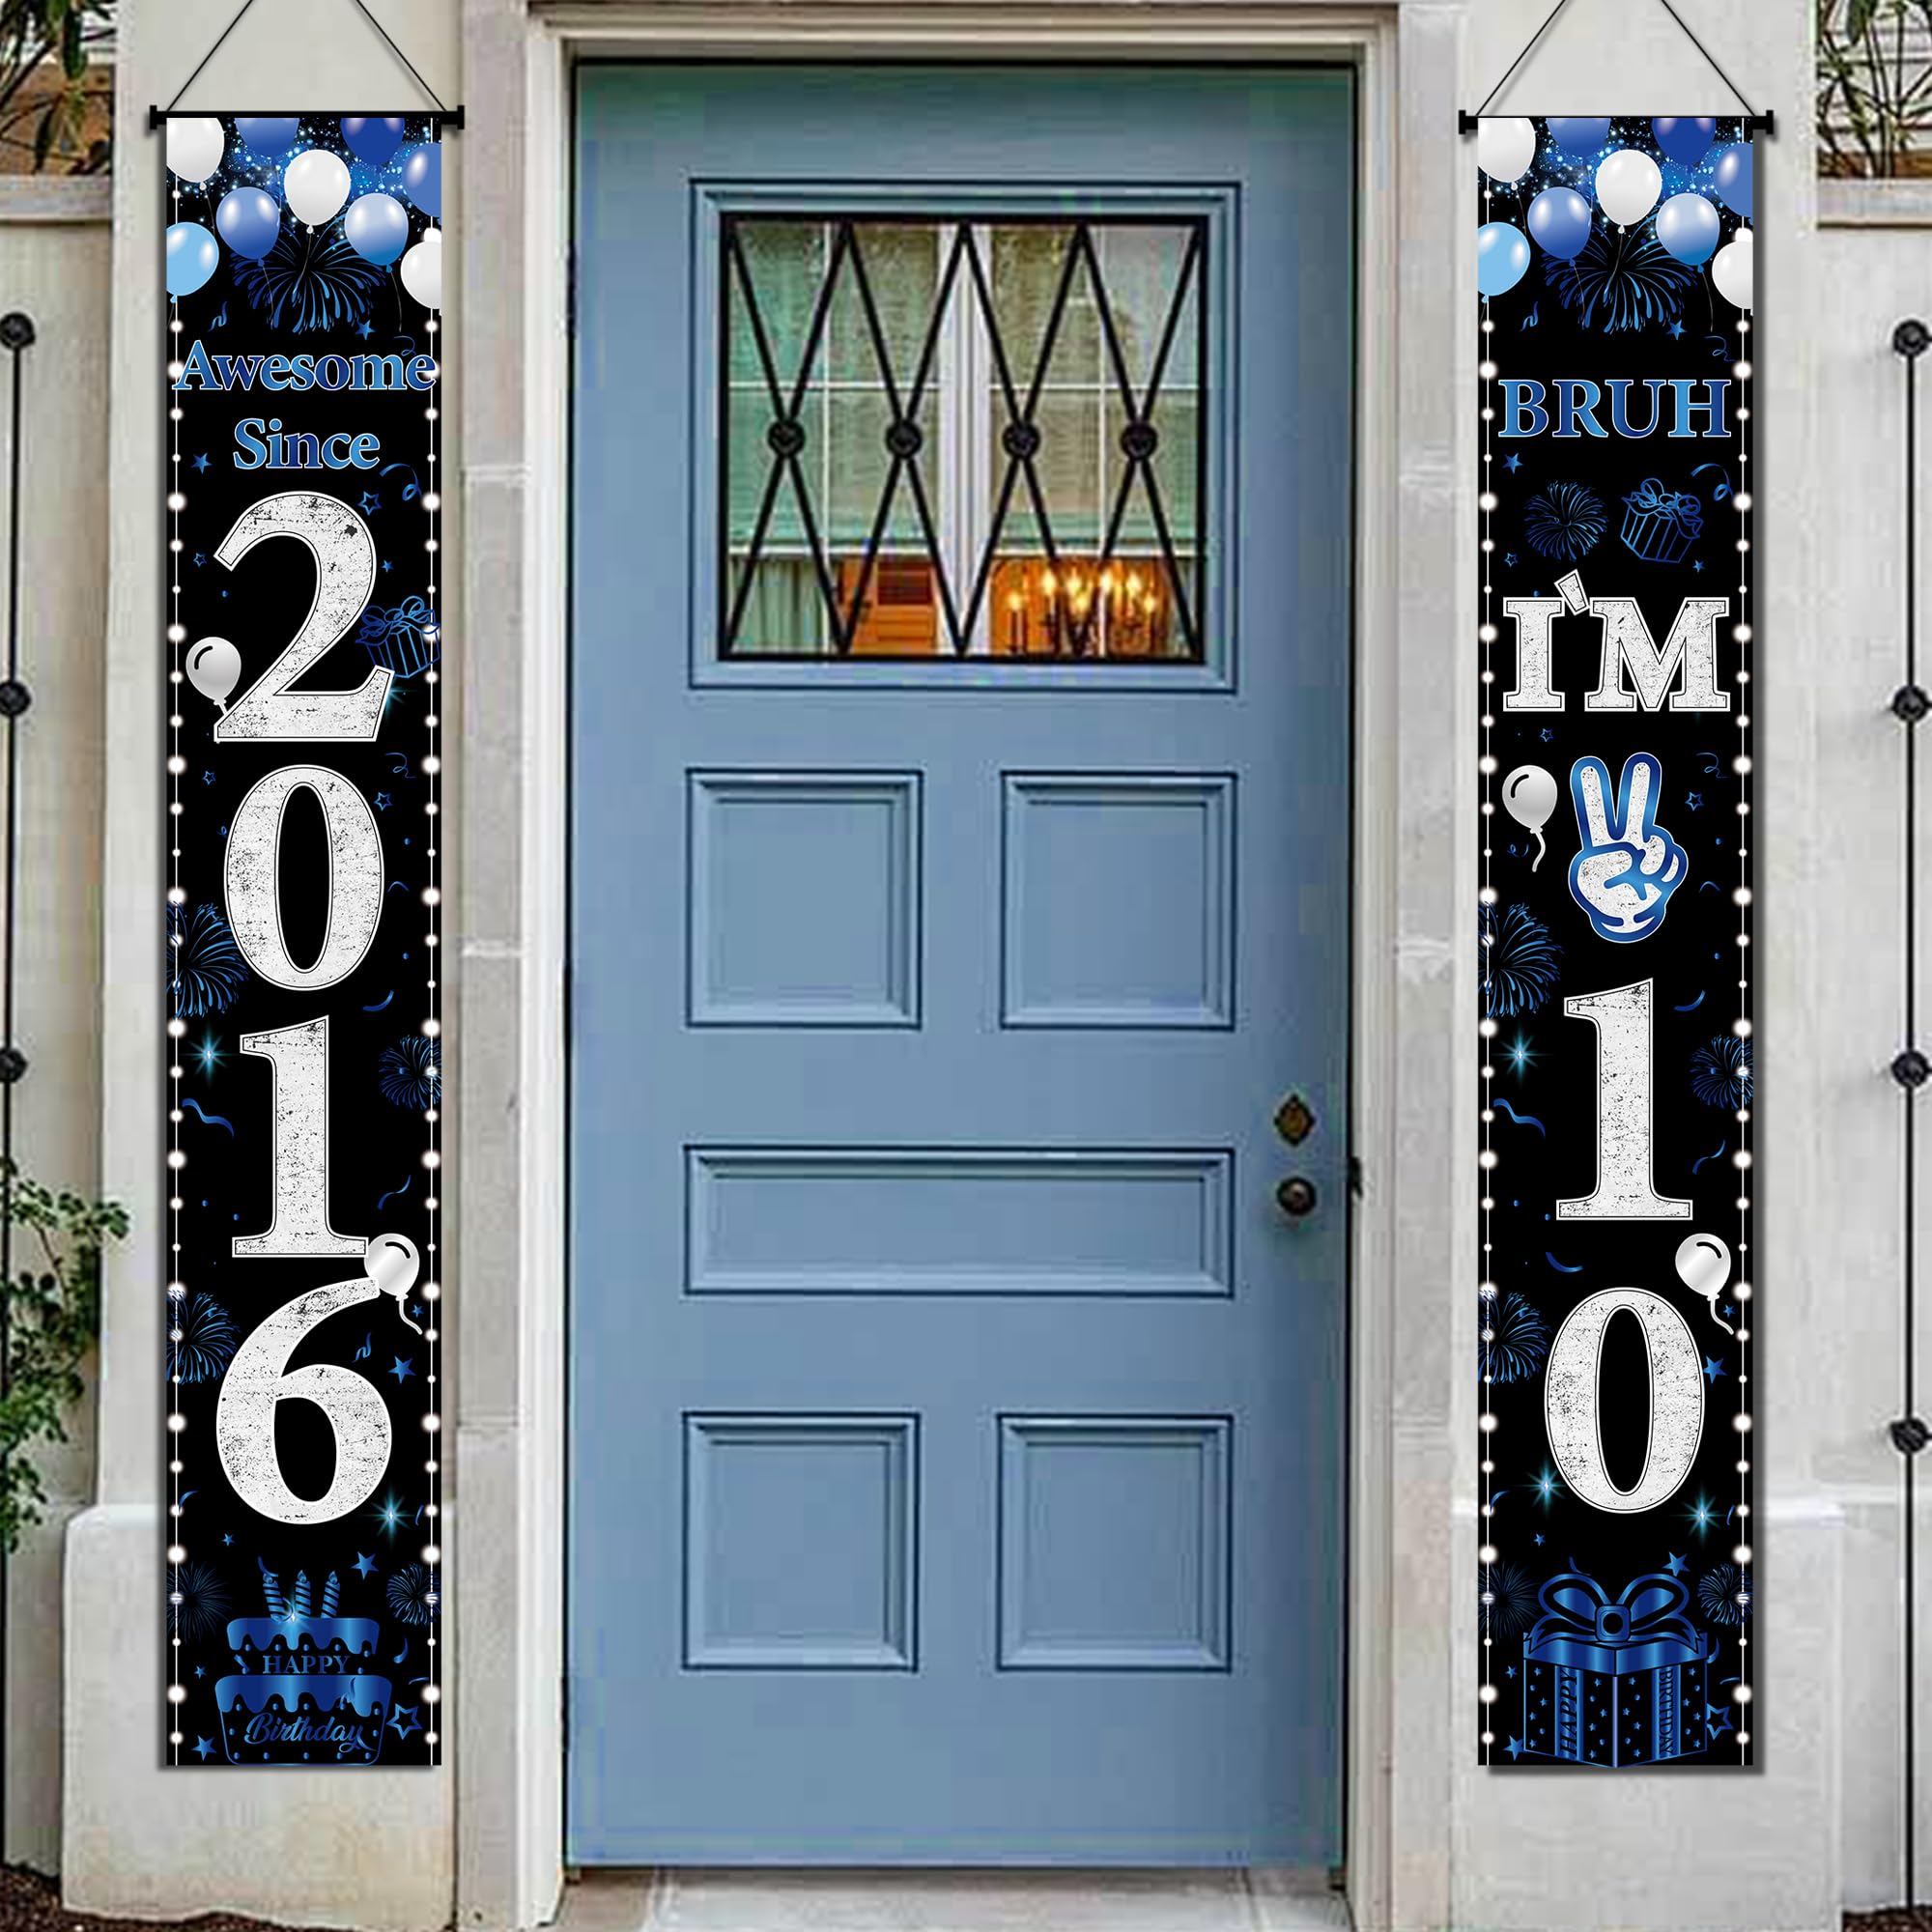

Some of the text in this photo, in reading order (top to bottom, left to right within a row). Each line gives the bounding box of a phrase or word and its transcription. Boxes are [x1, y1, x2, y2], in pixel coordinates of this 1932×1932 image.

[171, 339, 437, 390] Awesome
[233, 418, 380, 469] Since
[1497, 379, 1732, 439] BRUH
[1502, 568, 1731, 712] I'M
[213, 491, 394, 1524] 2016
[1546, 978, 1706, 1514] 10
[263, 1655, 351, 1674] HAPPY
[243, 1712, 363, 1753] Birthday
[1559, 1667, 1578, 1755] HAPPY
[1659, 1667, 1673, 1754] BIRTHDAY
